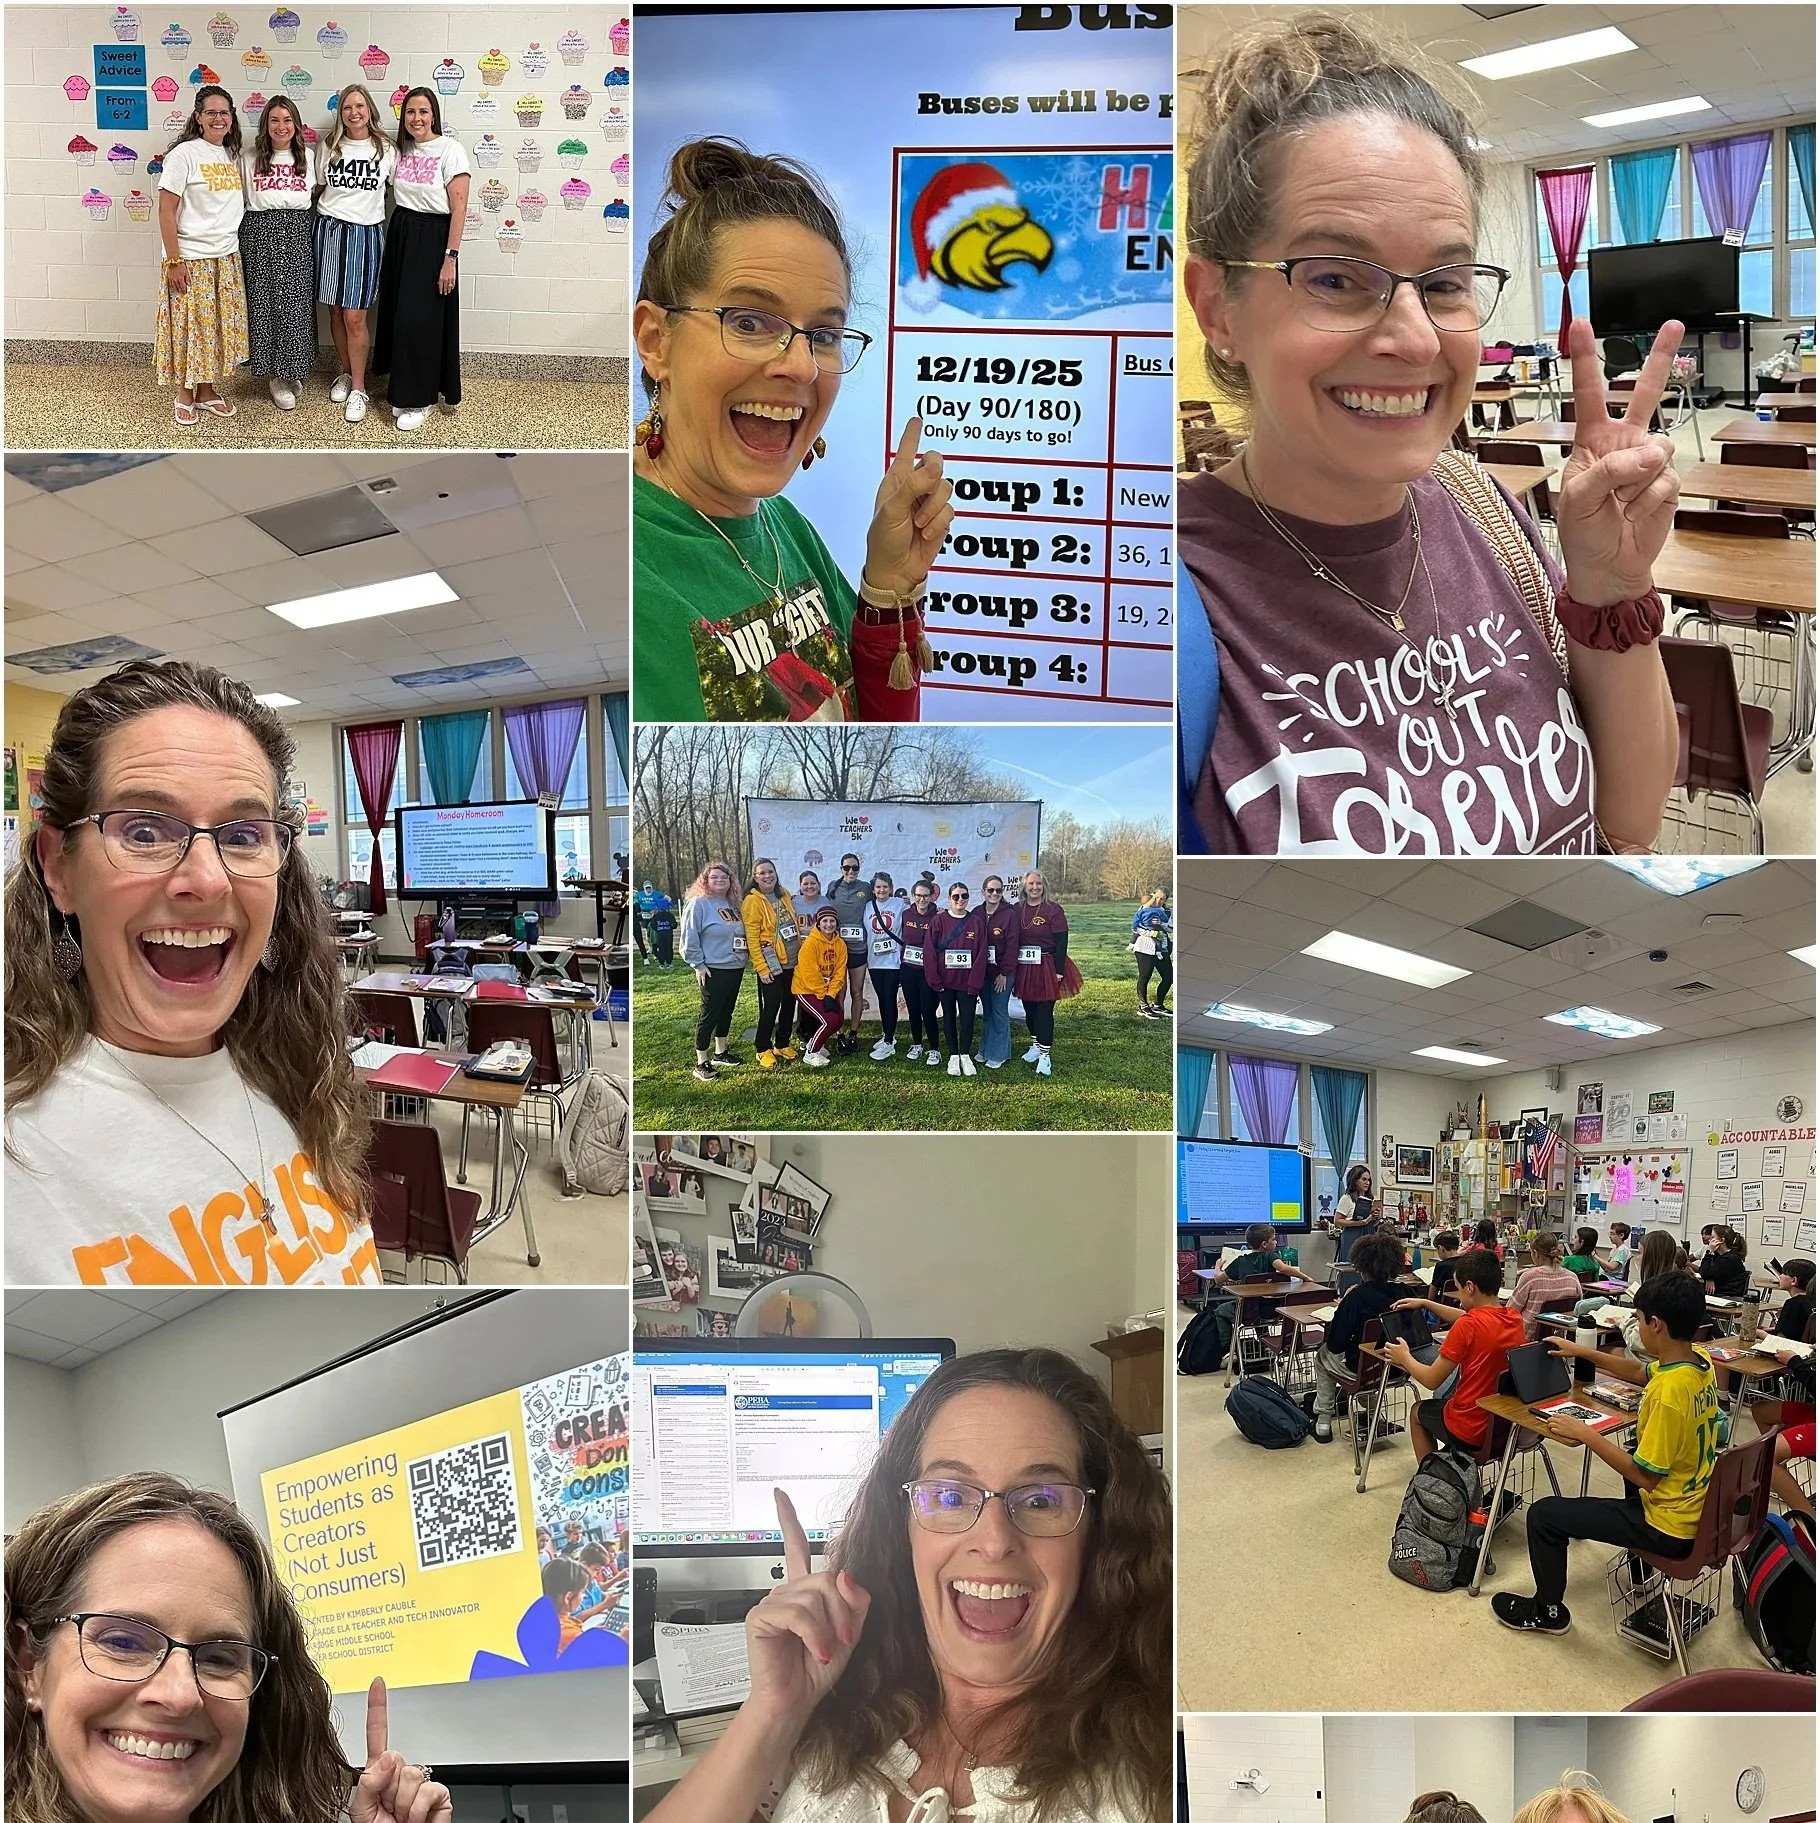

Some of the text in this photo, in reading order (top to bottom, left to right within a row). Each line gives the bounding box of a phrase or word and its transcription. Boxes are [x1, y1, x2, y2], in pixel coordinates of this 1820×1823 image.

[101, 51, 138, 61] Sweet
[99, 65, 142, 76] Advice
[106, 96, 136, 106] From
[918, 90, 1150, 114] Buses will be
[113, 110, 131, 119] 6-2
[328, 159, 380, 177] MATH
[328, 174, 377, 191] TEACHER
[1124, 354, 1162, 372] Bus
[917, 356, 1083, 387] 12/19/25
[979, 397, 1082, 427] 90/180)
[924, 425, 1072, 446] Only 90 days to go!
[1121, 488, 1170, 508] New
[1286, 616, 1511, 728] SCHOOL'S
[1398, 689, 1490, 776] OUT
[437, 810, 504, 820] Monday Homeroom
[845, 816, 858, 825] We
[840, 824, 872, 833] TEACHERS
[851, 833, 862, 841] 5k
[929, 855, 961, 864] TEACHERS
[935, 848, 948, 856] We
[940, 863, 951, 872] 5k
[851, 928, 860, 936] 75
[883, 940, 893, 949] 91
[956, 954, 968, 963] 93
[1025, 950, 1036, 958] 81
[760, 1211, 786, 1227] 2023
[747, 1396, 770, 1405] PEBA
[276, 1453, 399, 1503] Empowering
[279, 1483, 395, 1528] Students as
[283, 1520, 366, 1553] Creators
[287, 1541, 378, 1582] (Not Just
[1394, 1547, 1417, 1560] POLICE
[336, 1599, 416, 1622] BY CAUBLE
[351, 1603, 480, 1631] TEACHER AND TECH INNOVATOR
[336, 1631, 396, 1647] MIDDLE SCHOOL
[329, 1644, 394, 1661] SCHOOL DISTRICT
